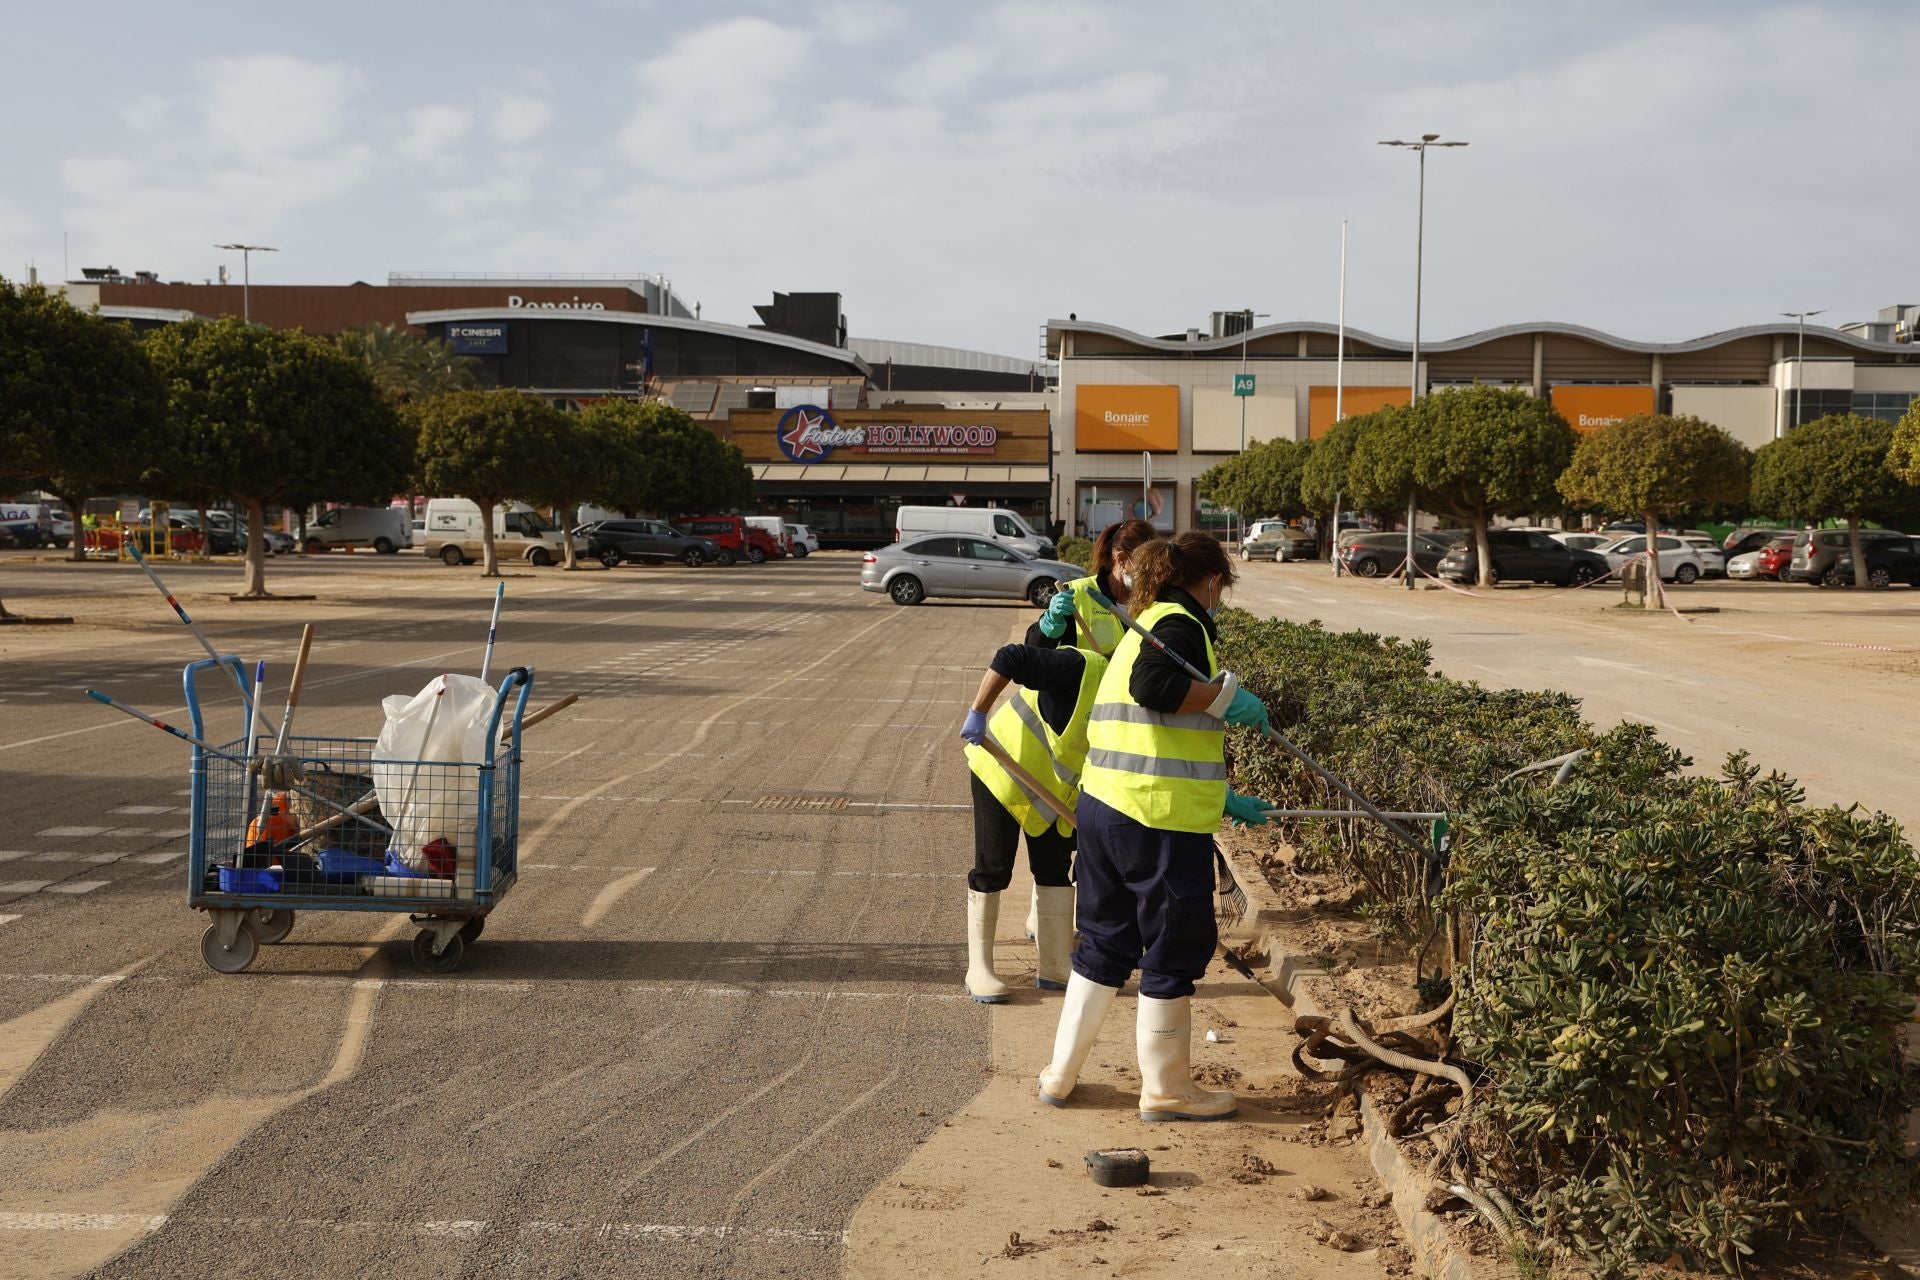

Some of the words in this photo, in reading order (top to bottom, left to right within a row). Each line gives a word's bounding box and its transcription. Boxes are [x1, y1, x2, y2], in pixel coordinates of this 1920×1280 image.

[461, 328, 501, 337] CINESA
[1237, 379, 1254, 390] A9
[1104, 410, 1150, 423] Bonaire
[799, 424, 866, 446] Foster's
[867, 425, 997, 446] HOLLYWOOD
